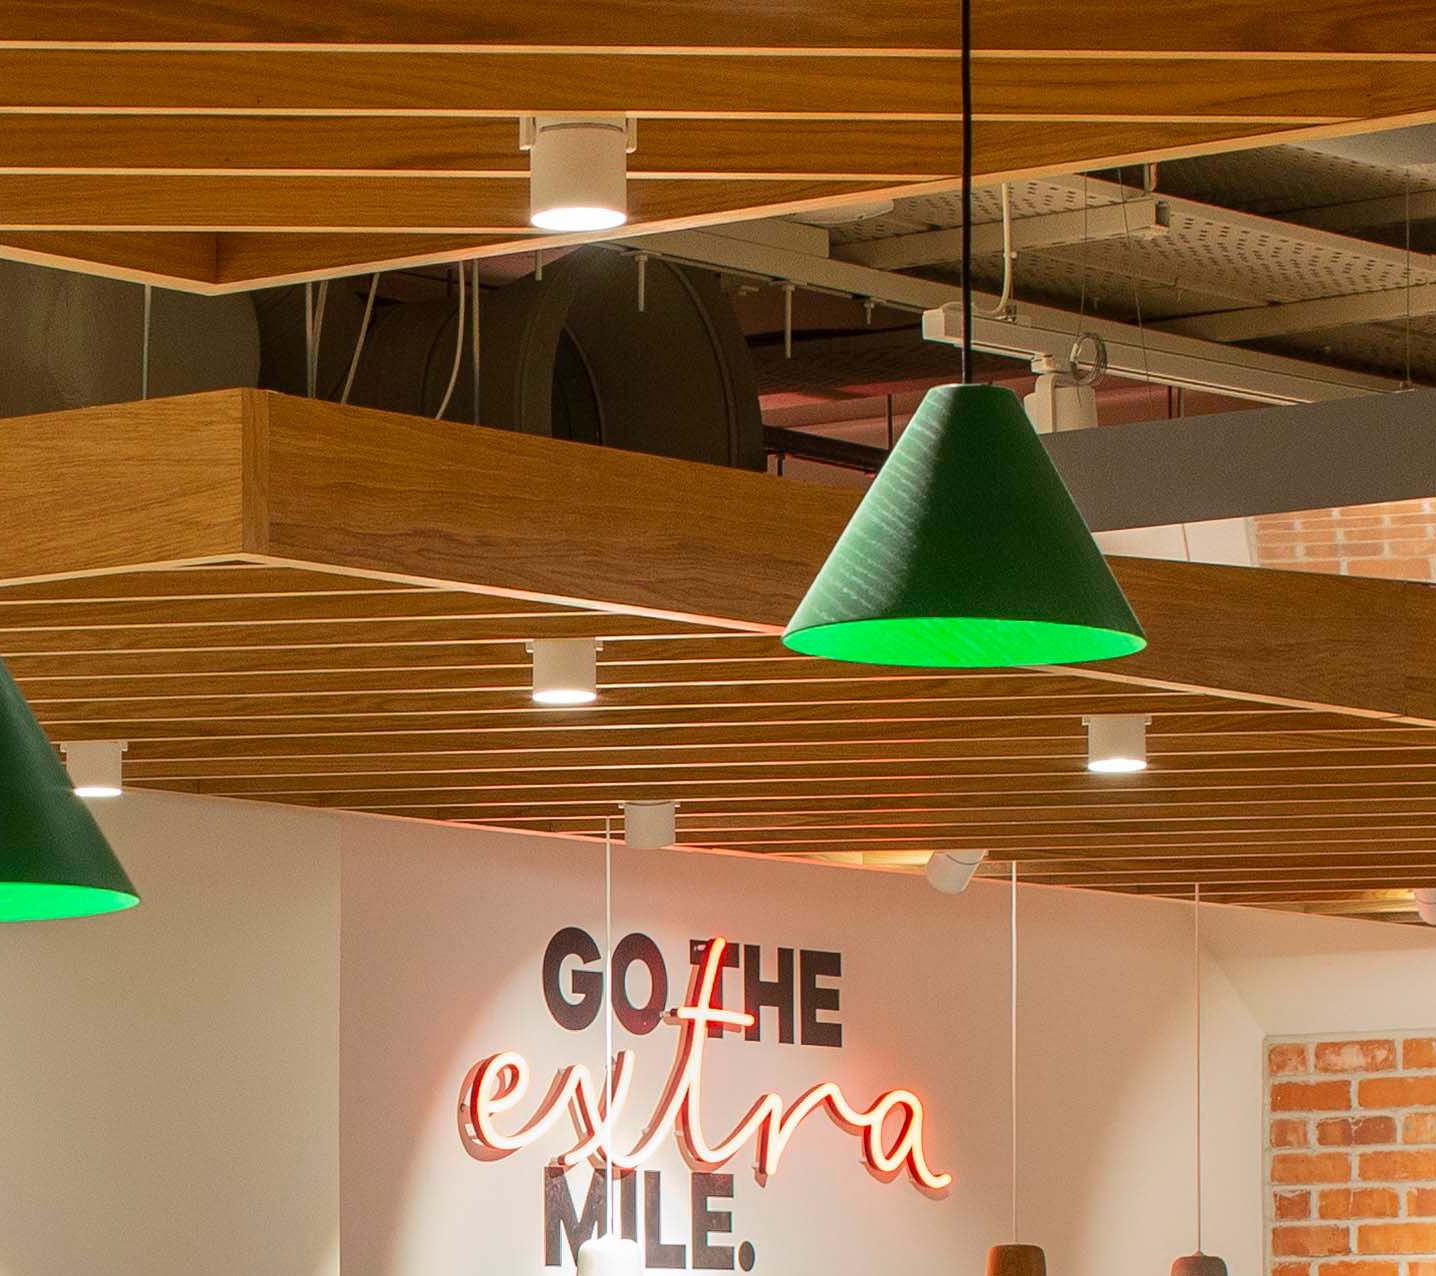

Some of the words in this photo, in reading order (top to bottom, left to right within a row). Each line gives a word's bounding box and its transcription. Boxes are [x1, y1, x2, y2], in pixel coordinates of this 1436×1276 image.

[542, 926, 669, 1037] GO
[689, 939, 843, 1048] THE
[470, 936, 953, 1191] extra
[544, 1165, 757, 1272] MILE.
